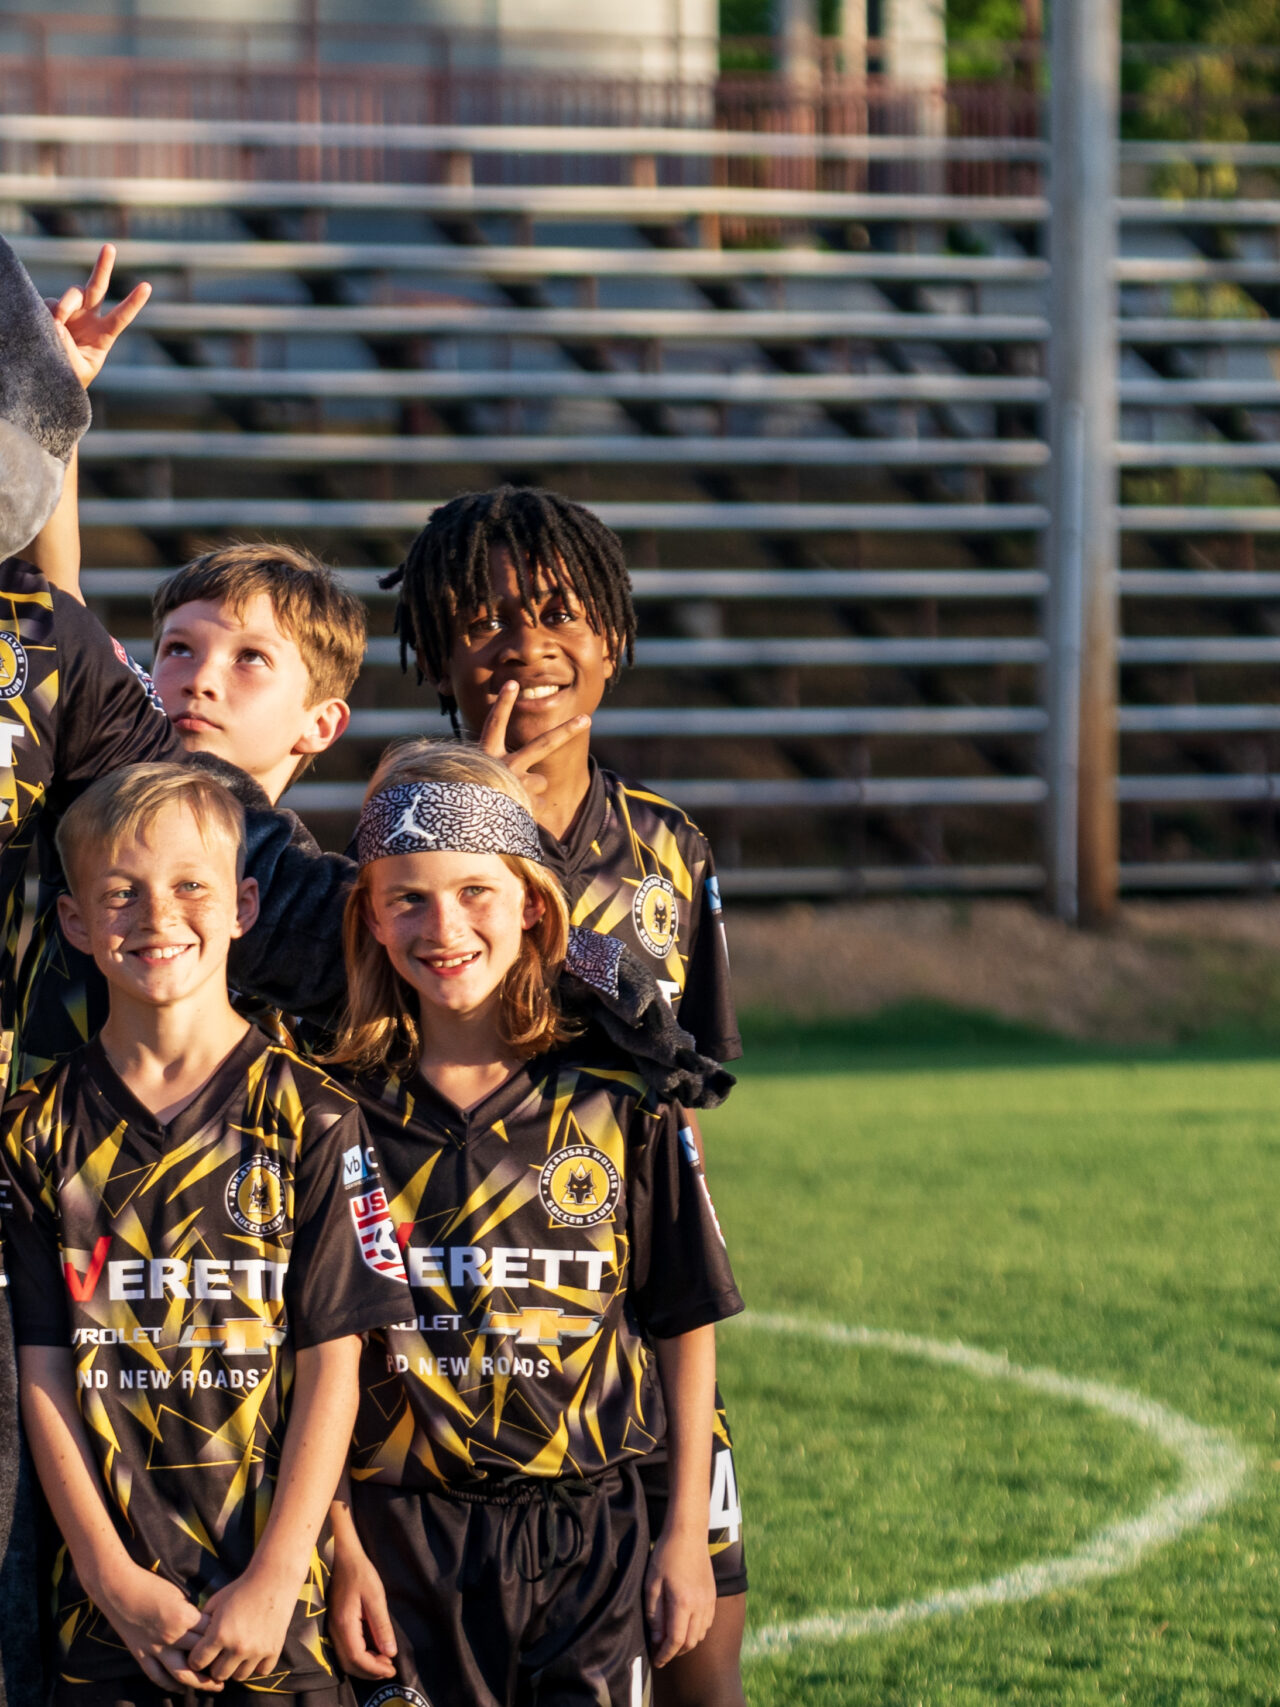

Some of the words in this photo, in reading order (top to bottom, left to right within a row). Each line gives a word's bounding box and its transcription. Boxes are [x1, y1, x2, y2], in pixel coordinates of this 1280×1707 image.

[4, 678, 23, 696] CLUB
[542, 1147, 591, 1186] ARKANSAS
[592, 1151, 618, 1189] WOLVES
[546, 1199, 584, 1225] SOCCER
[586, 1202, 612, 1224] CLUB
[60, 1236, 289, 1301] VERETT
[404, 1235, 614, 1291] ERETT
[79, 1370, 109, 1390] ND
[120, 1369, 171, 1390] NEW
[181, 1369, 261, 1390] ROADS
[419, 1356, 470, 1376] NEW
[481, 1356, 551, 1378] ROADS
